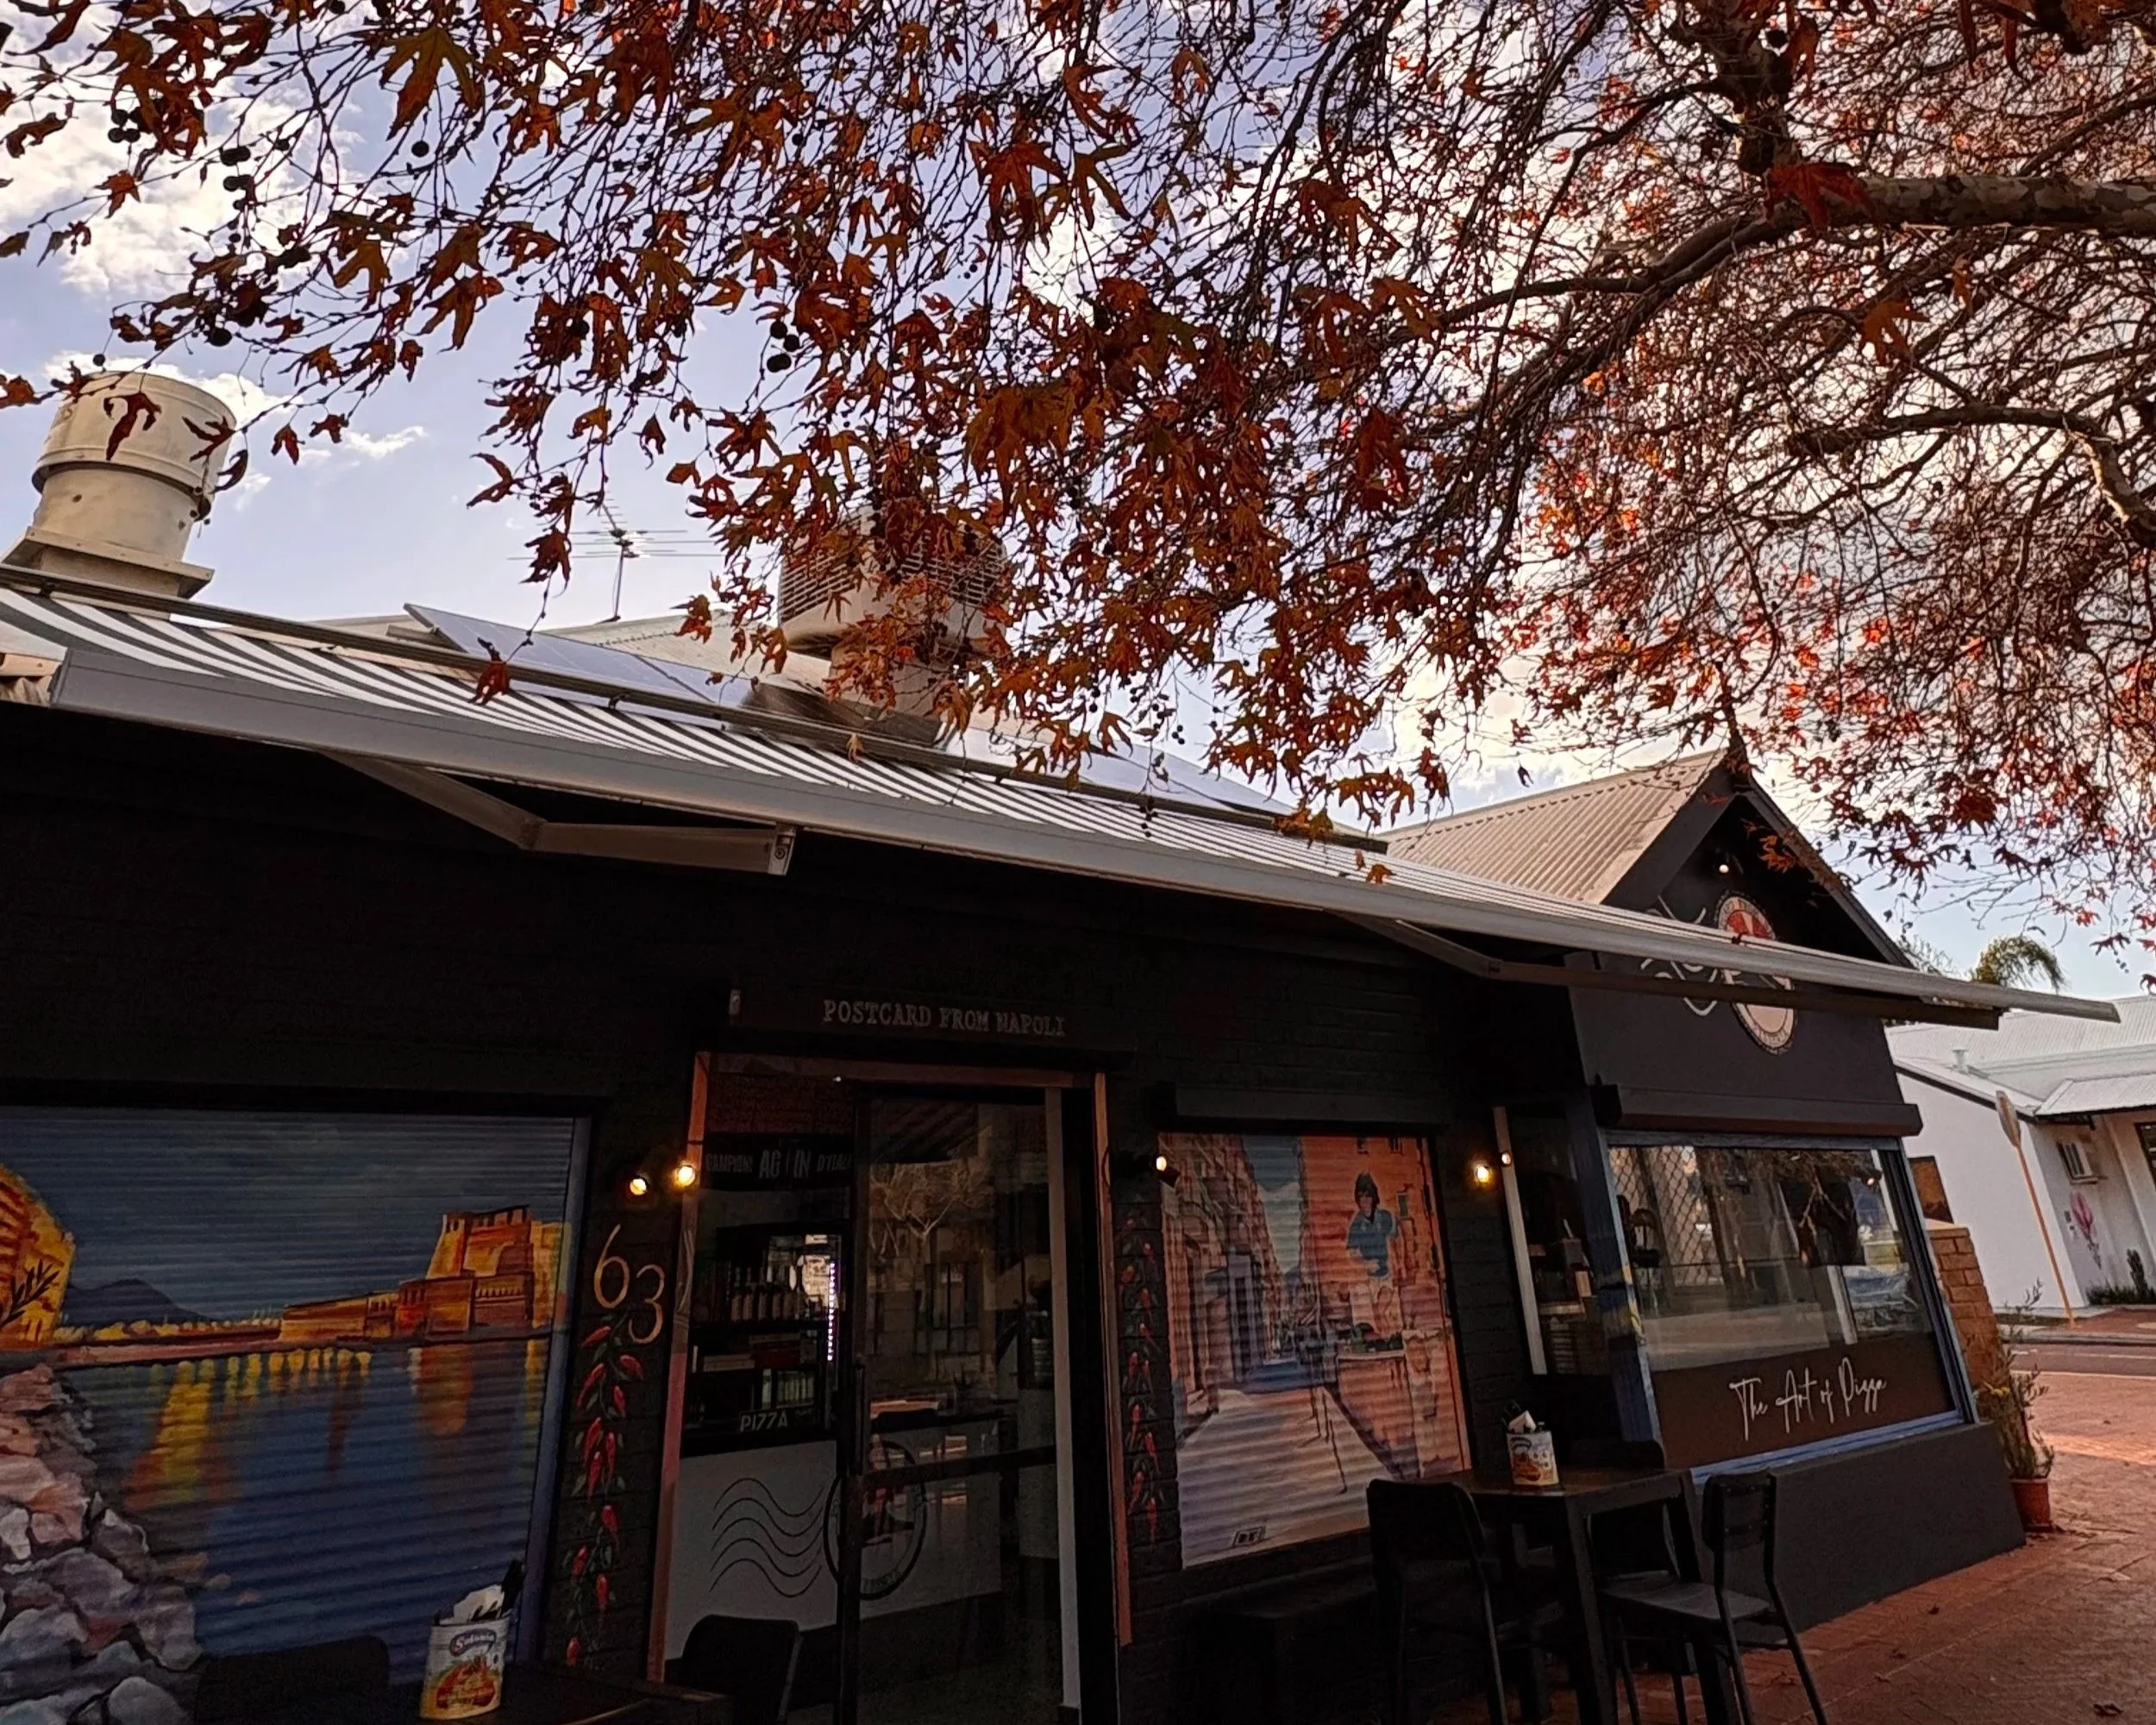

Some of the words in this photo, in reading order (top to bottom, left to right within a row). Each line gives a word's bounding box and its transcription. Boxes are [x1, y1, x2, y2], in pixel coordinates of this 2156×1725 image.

[823, 999, 931, 1027] POSTCARD
[940, 1007, 989, 1032] FROM
[997, 1012, 1066, 1035] NAPOLI
[593, 1224, 665, 1344] 63
[1729, 1377, 1768, 1440] The
[1775, 1367, 1817, 1433] Art
[1820, 1379, 1833, 1423] of
[1838, 1357, 1887, 1417] Pizza
